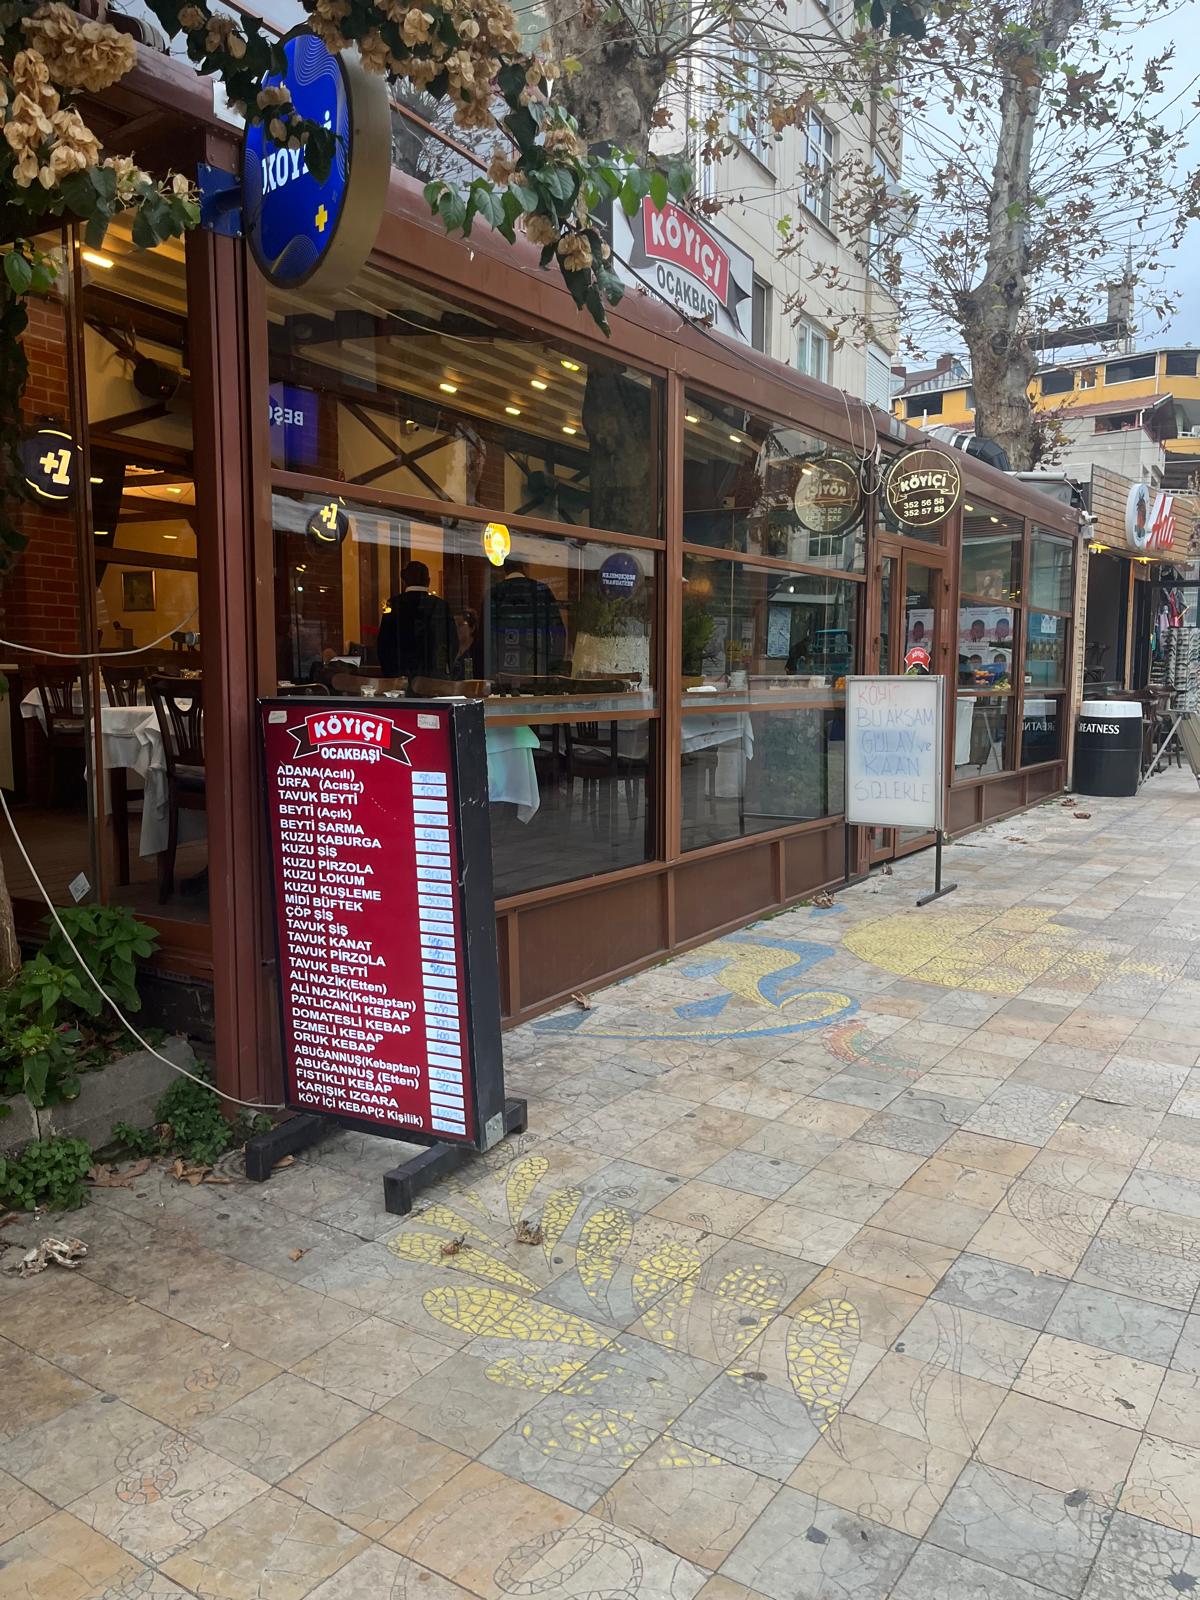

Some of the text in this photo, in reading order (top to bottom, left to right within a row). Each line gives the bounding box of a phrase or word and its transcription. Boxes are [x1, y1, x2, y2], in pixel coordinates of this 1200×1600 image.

[40, 449, 71, 485] +1
[900, 472, 947, 492] KÖYİÇİ
[903, 497, 944, 509] 352 56 58
[903, 506, 945, 518] 352 57 58
[314, 715, 383, 741] KÖYİÇİ
[1078, 722, 1120, 735] REATNESS
[321, 747, 380, 763] OCAKBAŞI
[278, 777, 364, 793] URFA (Acısız)
[278, 790, 358, 805] TAVUK BEYTİ
[279, 805, 351, 820] BEYTİ (Açık)
[280, 819, 364, 834] BEYTİ SARMA
[281, 831, 381, 848] KUZU KABURGA
[282, 844, 337, 858] KUZU ŞİŞ
[283, 857, 373, 874] KUZU PİRZOLA
[284, 869, 365, 885] KUZU LOKUM
[284, 882, 381, 900] KUZU KUŞLEME
[285, 894, 363, 911] MİDİ BÜFTEK
[286, 906, 333, 921] ÇÖP ŞİŞ
[287, 917, 348, 937] TAVUK ŞİŞ
[288, 932, 372, 951] TAVUK KANAT
[288, 944, 386, 967] TAVUK PİRZOLA
[289, 957, 368, 977] TAVUK BEYTİ
[290, 970, 308, 981] ALİ
[290, 983, 309, 994] ALİ
[291, 995, 410, 1021] PATLICANLI KEBAP
[292, 1008, 411, 1034] DOMATESLİ KEBAP
[293, 1020, 383, 1042] EZMELİ KEBAP
[294, 1032, 375, 1053] ORUK KEBAP
[295, 1057, 419, 1089] ABUĞANNUŞ (Etten)
[296, 1069, 392, 1094] FISTIKLI KEBAP
[297, 1081, 398, 1108] KARIŞIK IZGARA
[299, 1092, 320, 1103] KÖY
[323, 1097, 336, 1108] İÇİ
[387, 1110, 423, 1127] Kişilik)
